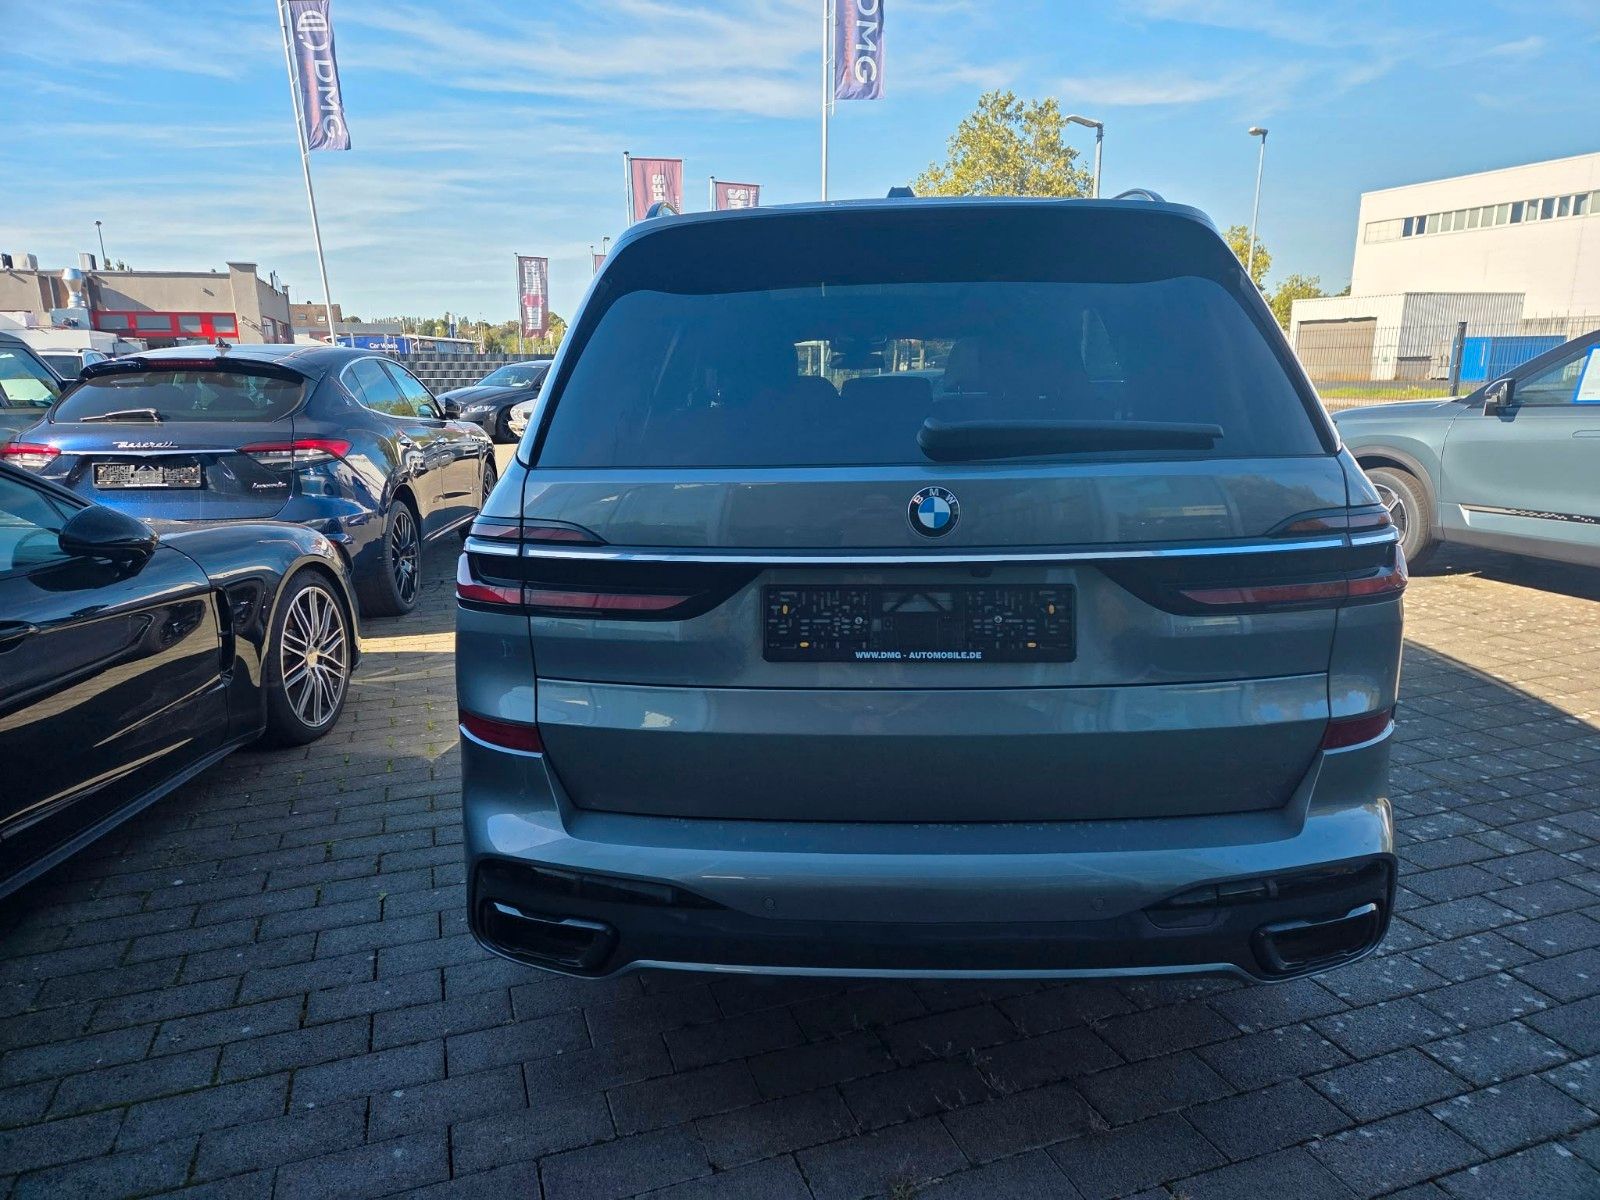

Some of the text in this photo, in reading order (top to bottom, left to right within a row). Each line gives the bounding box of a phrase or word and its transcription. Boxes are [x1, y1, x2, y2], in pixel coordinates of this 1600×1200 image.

[314, 59, 342, 139] DMG
[112, 441, 179, 449] Maserati
[913, 488, 956, 505] BMW
[855, 651, 902, 659] WWW.DMG
[908, 651, 982, 659] AUTOMOBILE.DE
